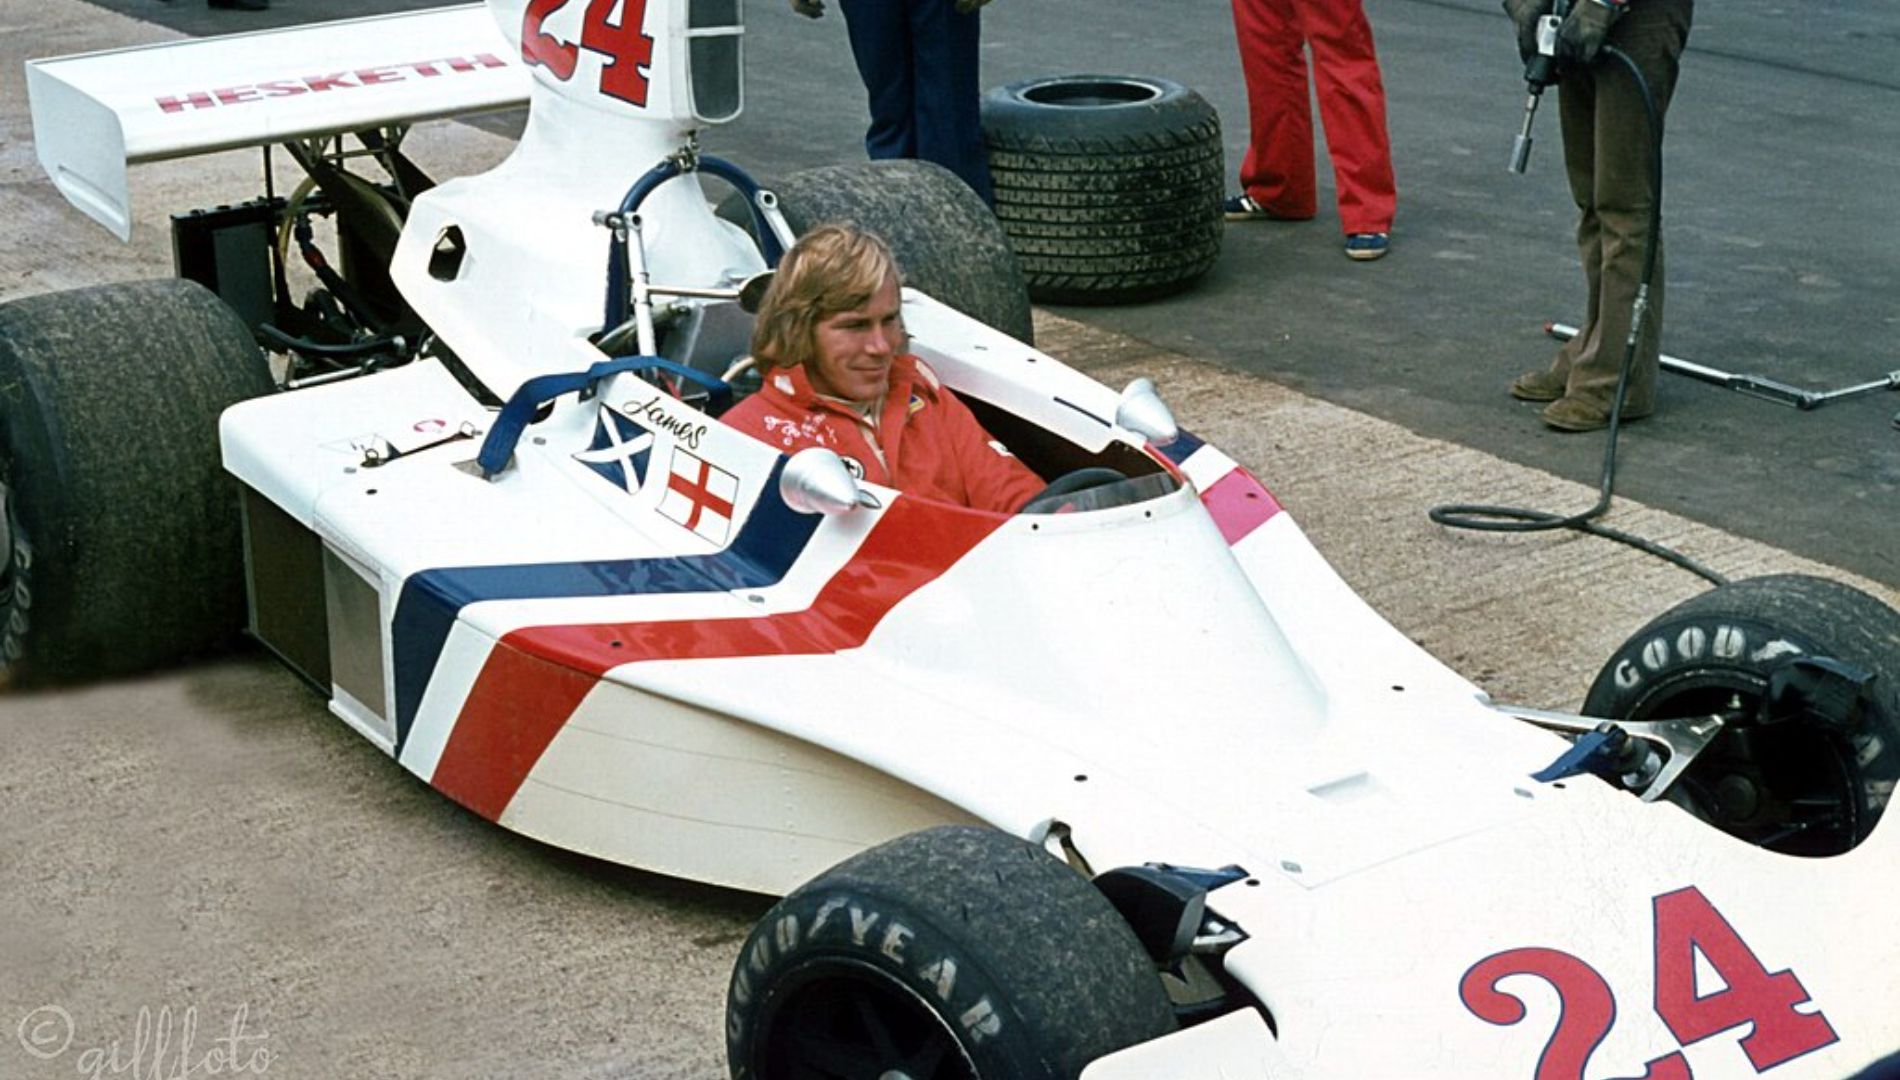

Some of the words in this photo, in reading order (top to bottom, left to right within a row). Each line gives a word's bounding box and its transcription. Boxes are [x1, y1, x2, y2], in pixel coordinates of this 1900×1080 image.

[154, 52, 508, 114] HESKETH
[521, 0, 655, 108] 24
[622, 396, 708, 450] James
[729, 896, 1001, 1043] GOODYEAR
[1458, 884, 1841, 1080] 24
